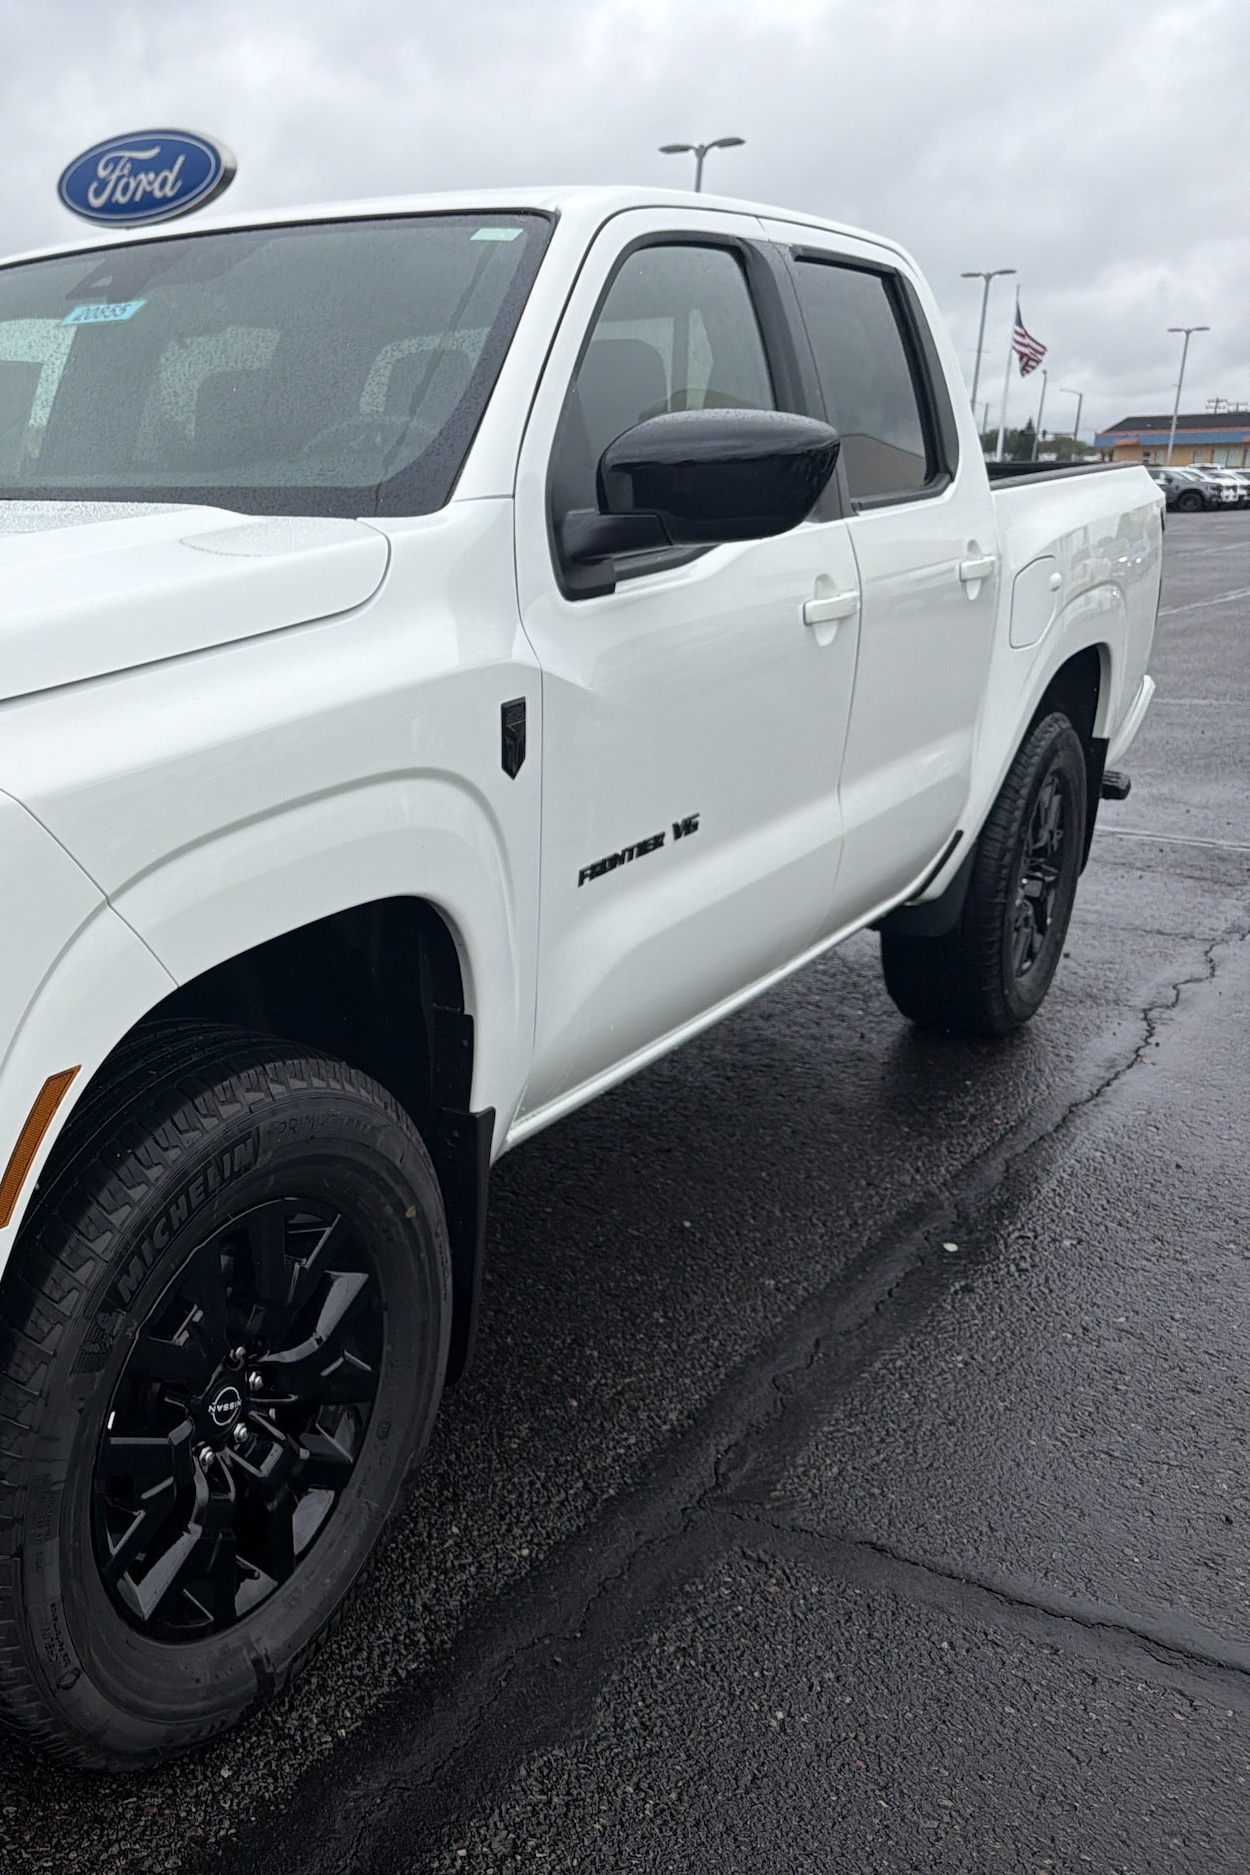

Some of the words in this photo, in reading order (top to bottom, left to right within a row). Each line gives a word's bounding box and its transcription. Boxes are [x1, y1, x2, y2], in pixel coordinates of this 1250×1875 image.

[87, 146, 186, 209] Ford
[577, 830, 666, 888] FRONTIER
[672, 812, 700, 842] V6
[116, 1136, 257, 1304] MICHELIN
[208, 1400, 241, 1413] NISSAN
